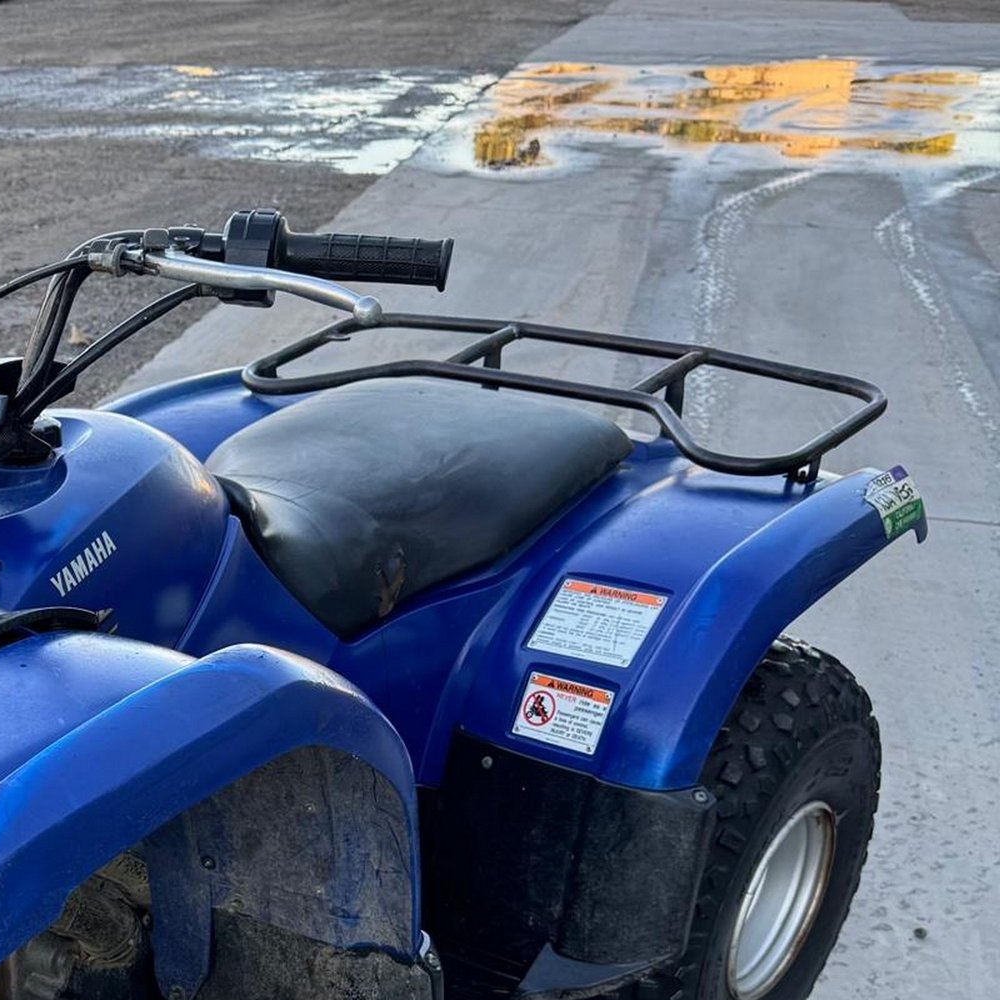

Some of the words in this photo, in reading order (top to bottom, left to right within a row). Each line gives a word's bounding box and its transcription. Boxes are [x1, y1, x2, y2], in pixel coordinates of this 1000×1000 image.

[50, 530, 117, 597] YAMAHA
[600, 589, 638, 601] WARNING
[557, 681, 594, 697] WARNING
[557, 693, 577, 703] NEVER
